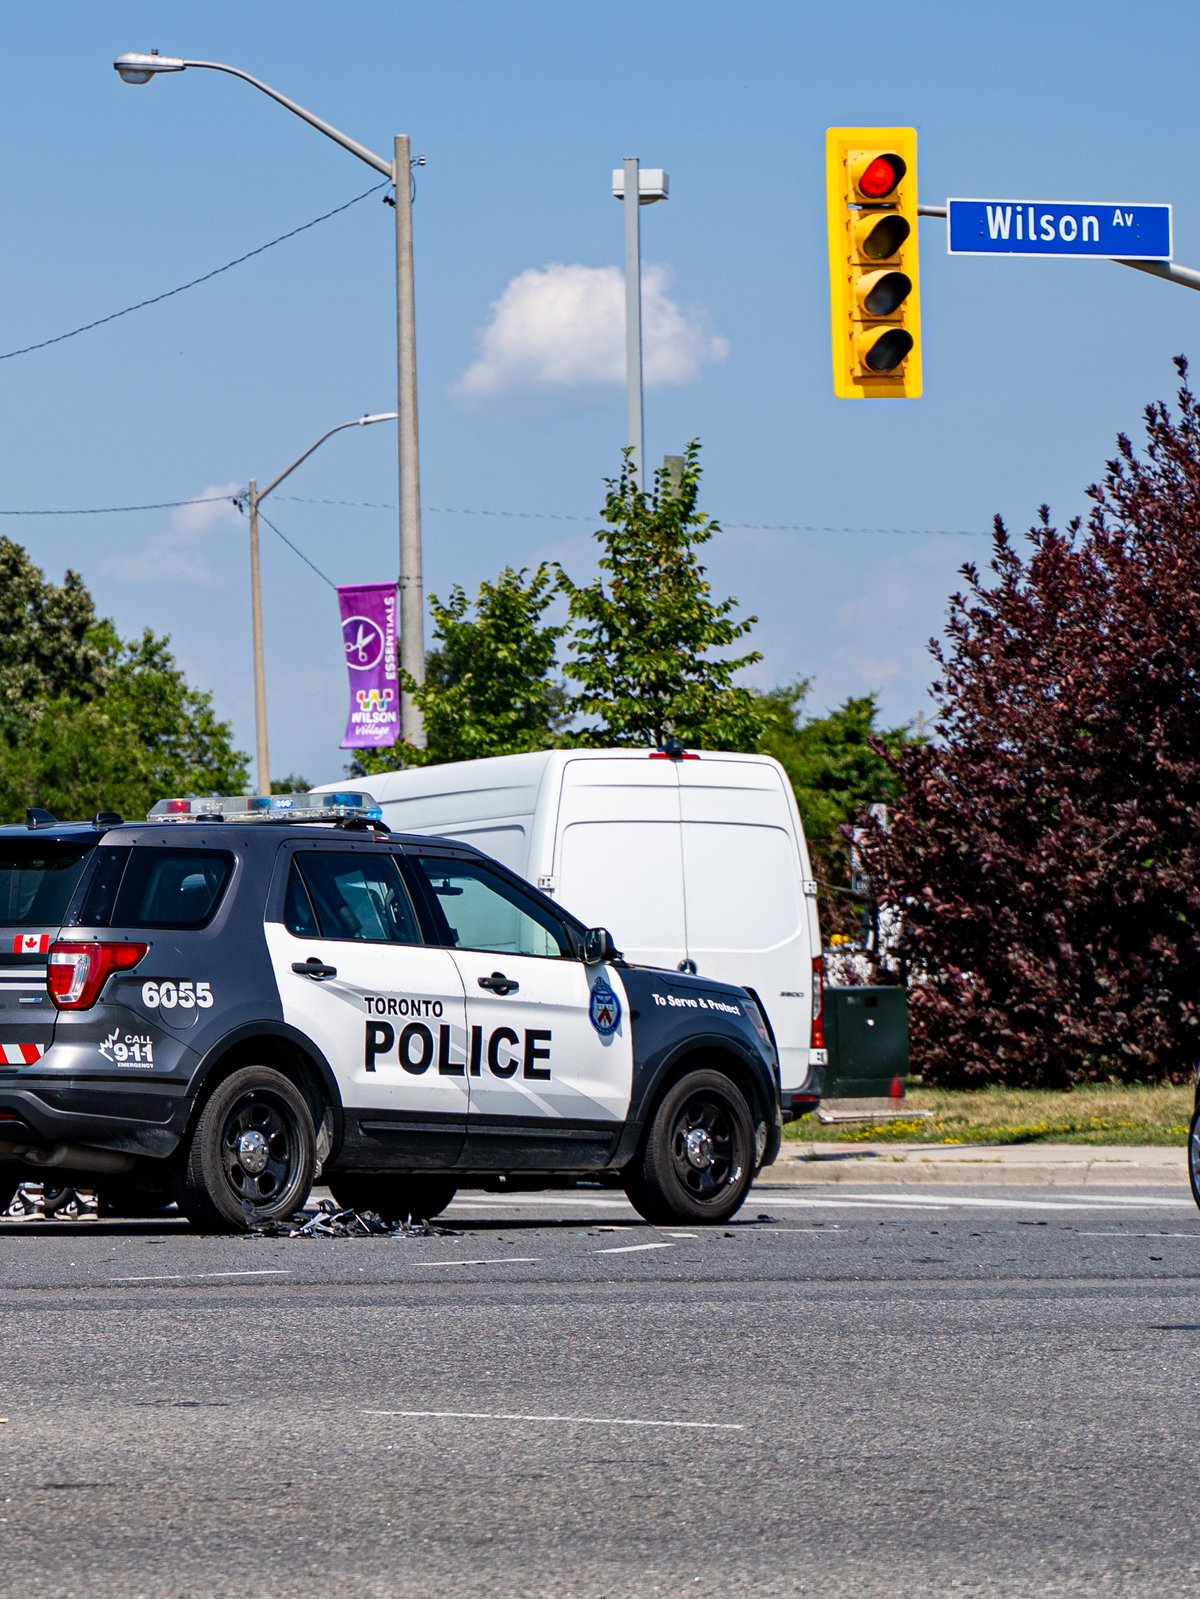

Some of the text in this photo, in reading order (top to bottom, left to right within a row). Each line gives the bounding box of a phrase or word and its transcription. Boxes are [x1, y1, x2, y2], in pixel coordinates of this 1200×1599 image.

[986, 205, 1133, 241] Wilson Av
[383, 596, 396, 680] ESSENTIALS
[351, 711, 396, 724] WILSON
[355, 724, 390, 740] Village
[141, 981, 214, 1008] 6055
[652, 994, 741, 1016] To Serve & Protect
[364, 997, 443, 1018] TORONTO
[125, 1035, 153, 1044] CALL
[113, 1043, 154, 1062] 9-1-1
[365, 1020, 552, 1081] POLICE
